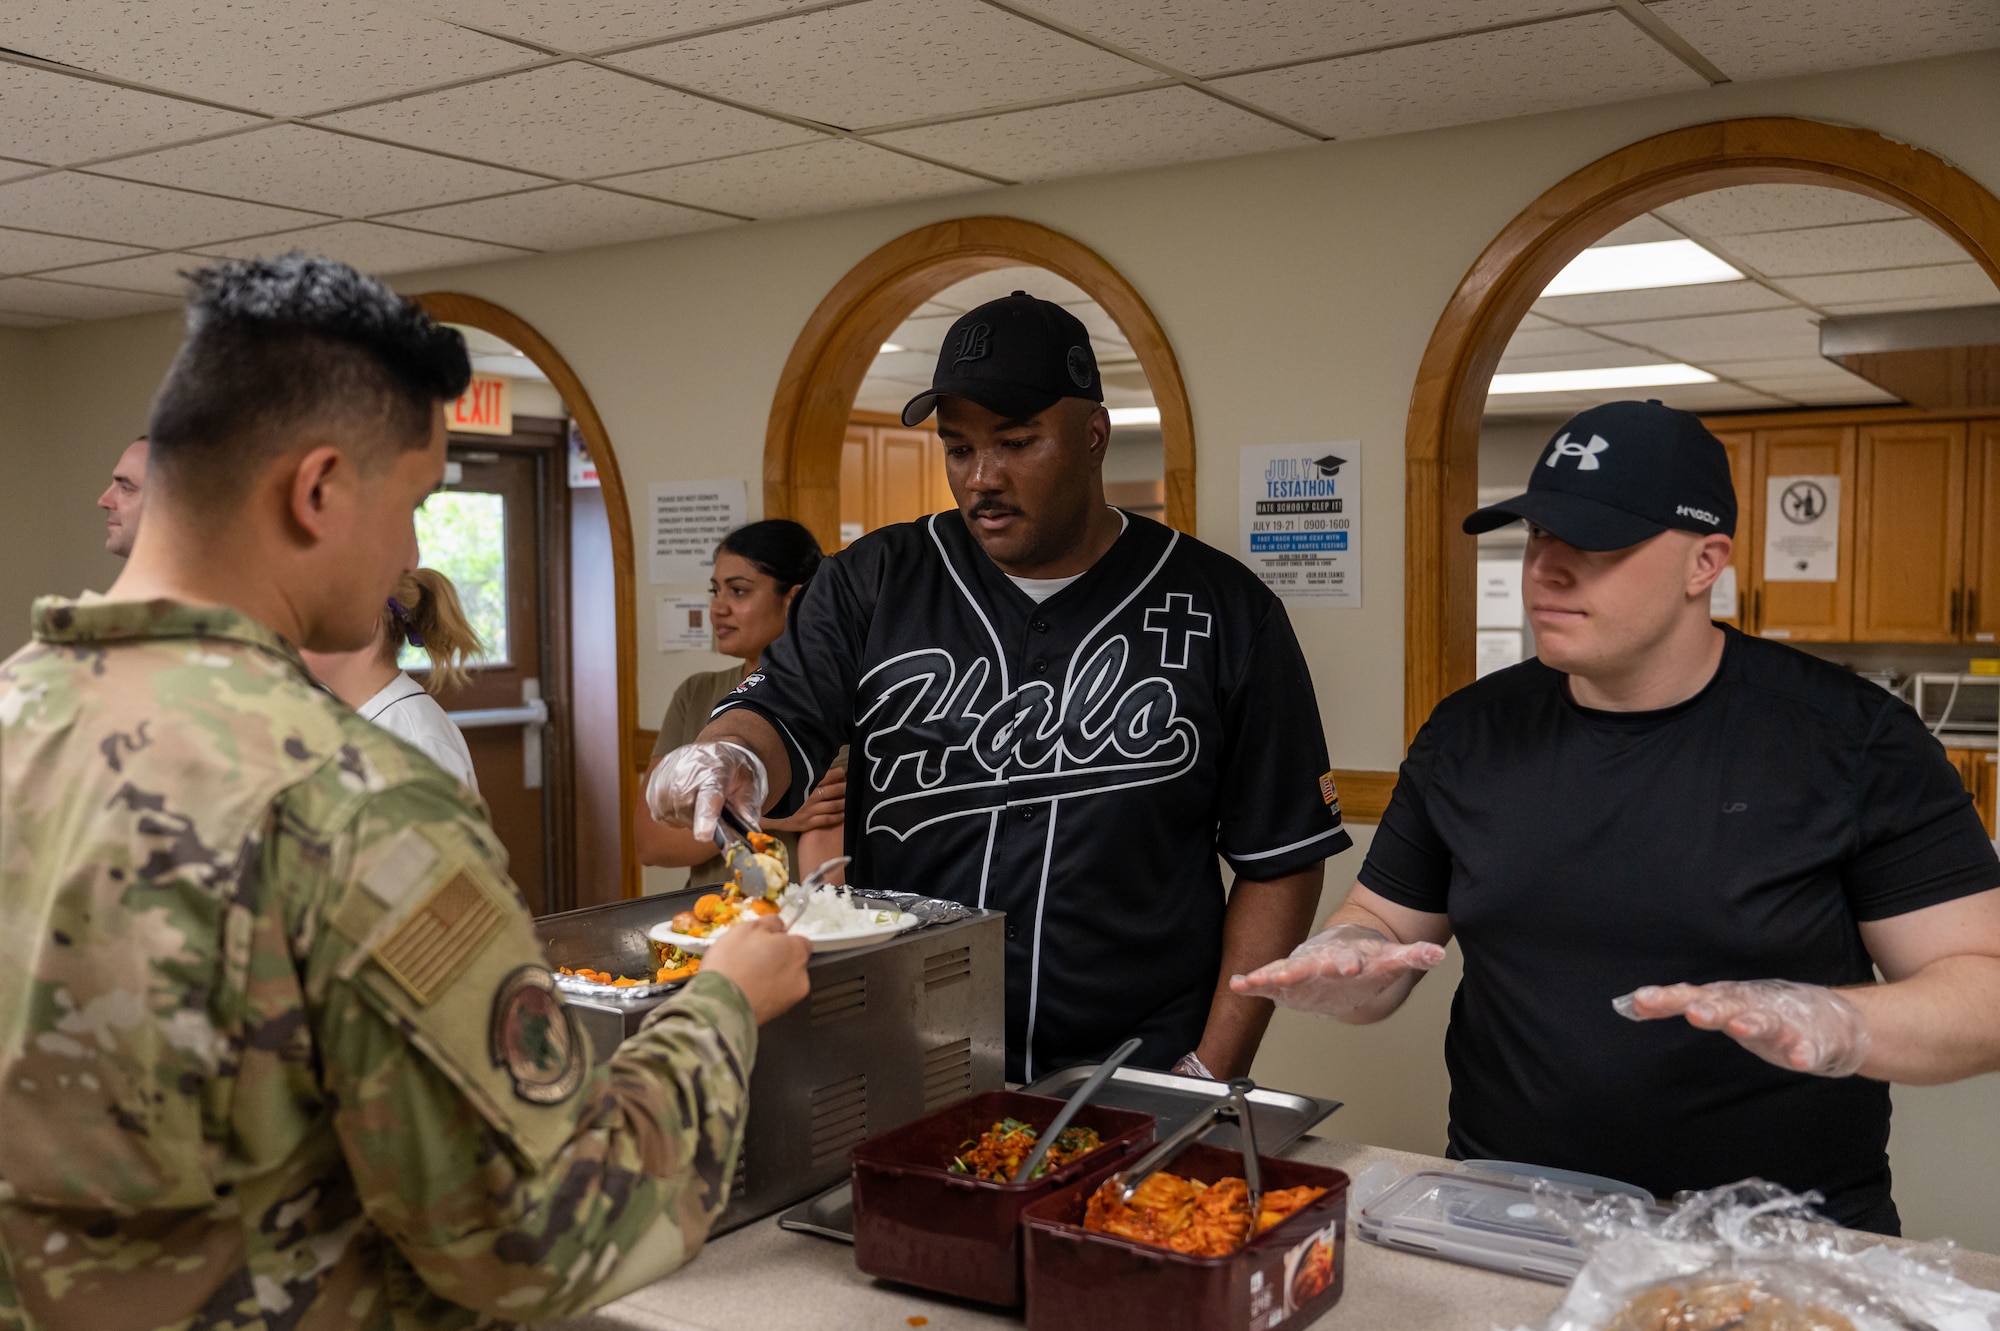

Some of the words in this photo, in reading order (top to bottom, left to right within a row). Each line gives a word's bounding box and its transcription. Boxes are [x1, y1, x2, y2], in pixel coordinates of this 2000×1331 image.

[455, 380, 503, 426] EXIT
[1265, 458, 1312, 480] JULY
[1267, 479, 1335, 498] TESTATHON
[1257, 502, 1274, 513] HATE
[1277, 502, 1309, 512] SCHOOL?
[1312, 502, 1329, 511] CLEP
[1332, 501, 1342, 511] IT!
[1253, 521, 1270, 531] JULY
[1274, 521, 1294, 530] 19-21
[1304, 519, 1350, 529] 0900-1600
[854, 634, 1199, 793] Halo
